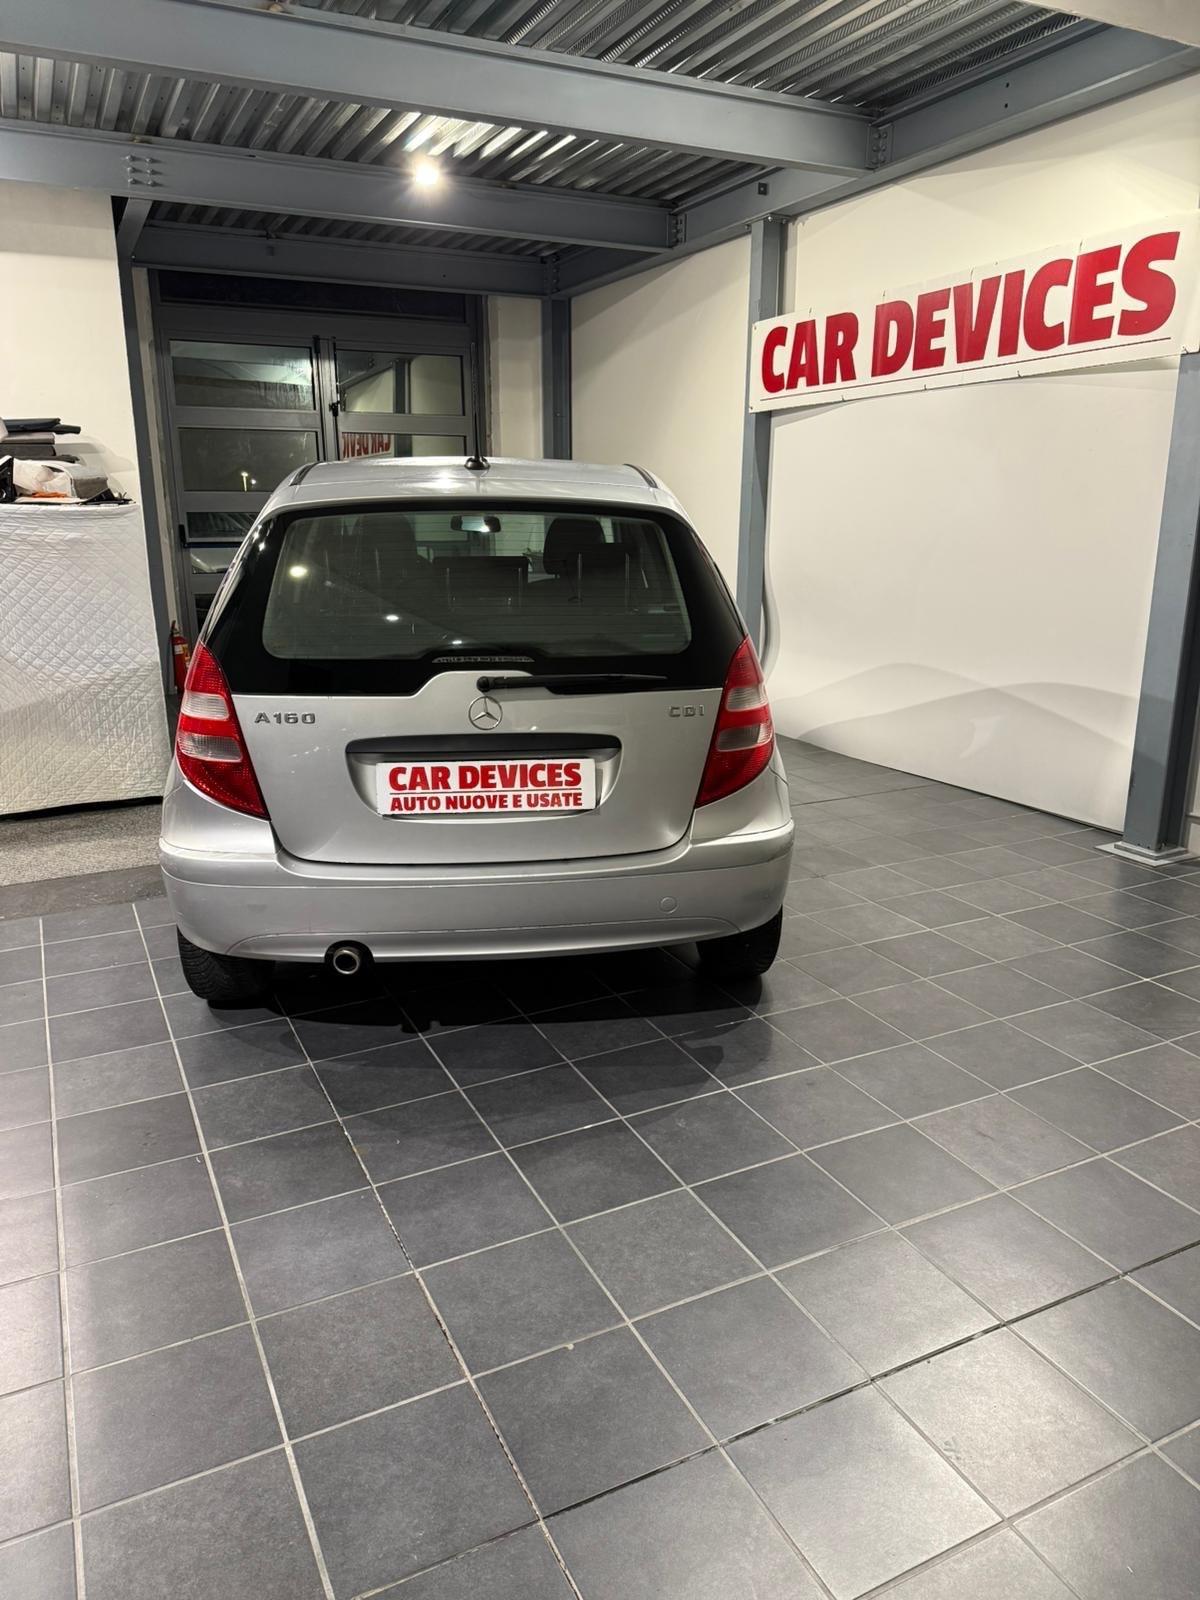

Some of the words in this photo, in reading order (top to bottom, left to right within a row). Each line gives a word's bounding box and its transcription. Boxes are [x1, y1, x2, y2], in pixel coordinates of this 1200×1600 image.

[761, 312, 858, 393] CAR
[871, 231, 1180, 377] DEVICES
[669, 705, 704, 717] CDI
[389, 766, 451, 791] CAR
[458, 763, 582, 789] DEVICES
[390, 796, 441, 811] AUTO
[445, 794, 508, 810] NUOVE
[513, 794, 522, 808] E
[527, 792, 583, 808] USATE
